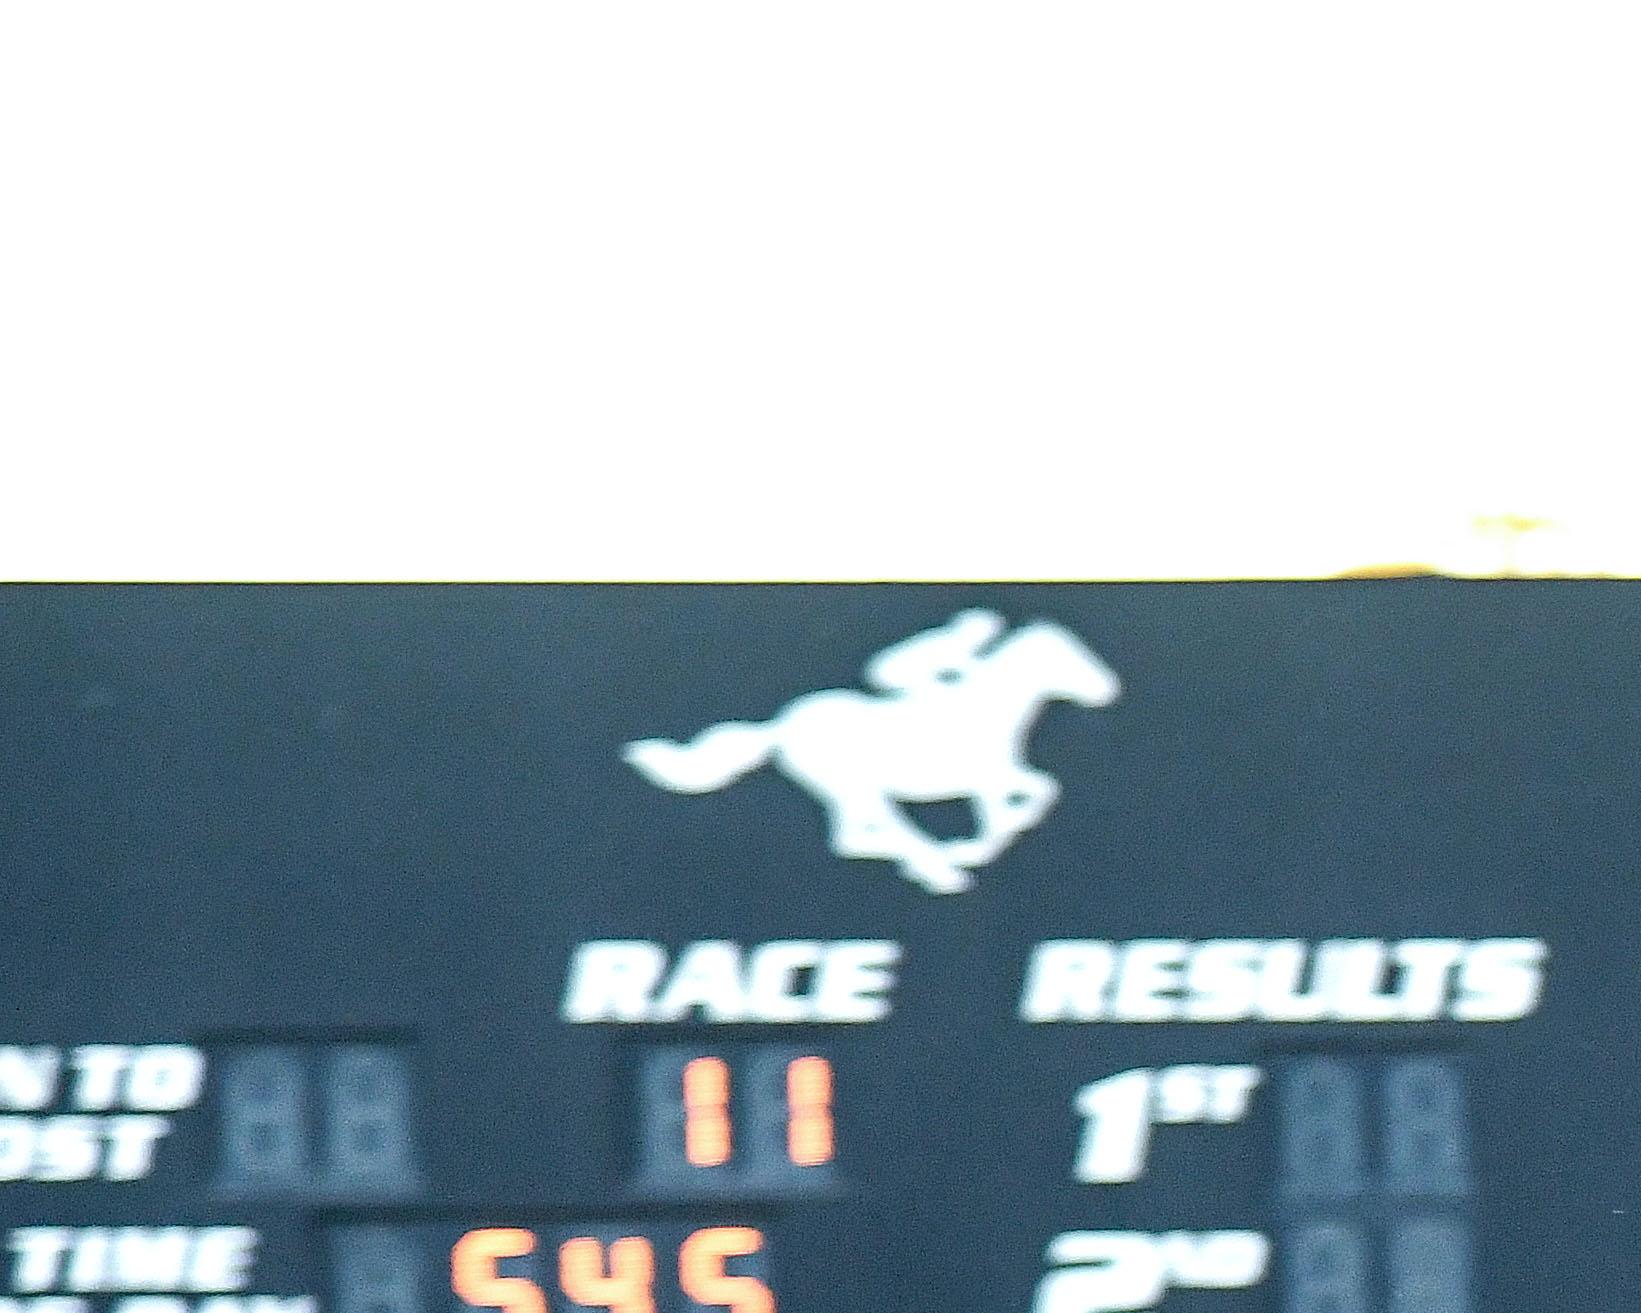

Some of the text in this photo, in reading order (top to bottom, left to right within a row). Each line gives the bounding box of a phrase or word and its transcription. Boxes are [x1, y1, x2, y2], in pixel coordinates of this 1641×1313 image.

[562, 938, 901, 1025] RACE
[1020, 936, 1549, 1024] RESULTS
[71, 1042, 207, 1112] TO
[682, 1055, 836, 1169] 11
[1075, 1063, 1263, 1184] 1ST
[9, 1225, 259, 1293] TIME
